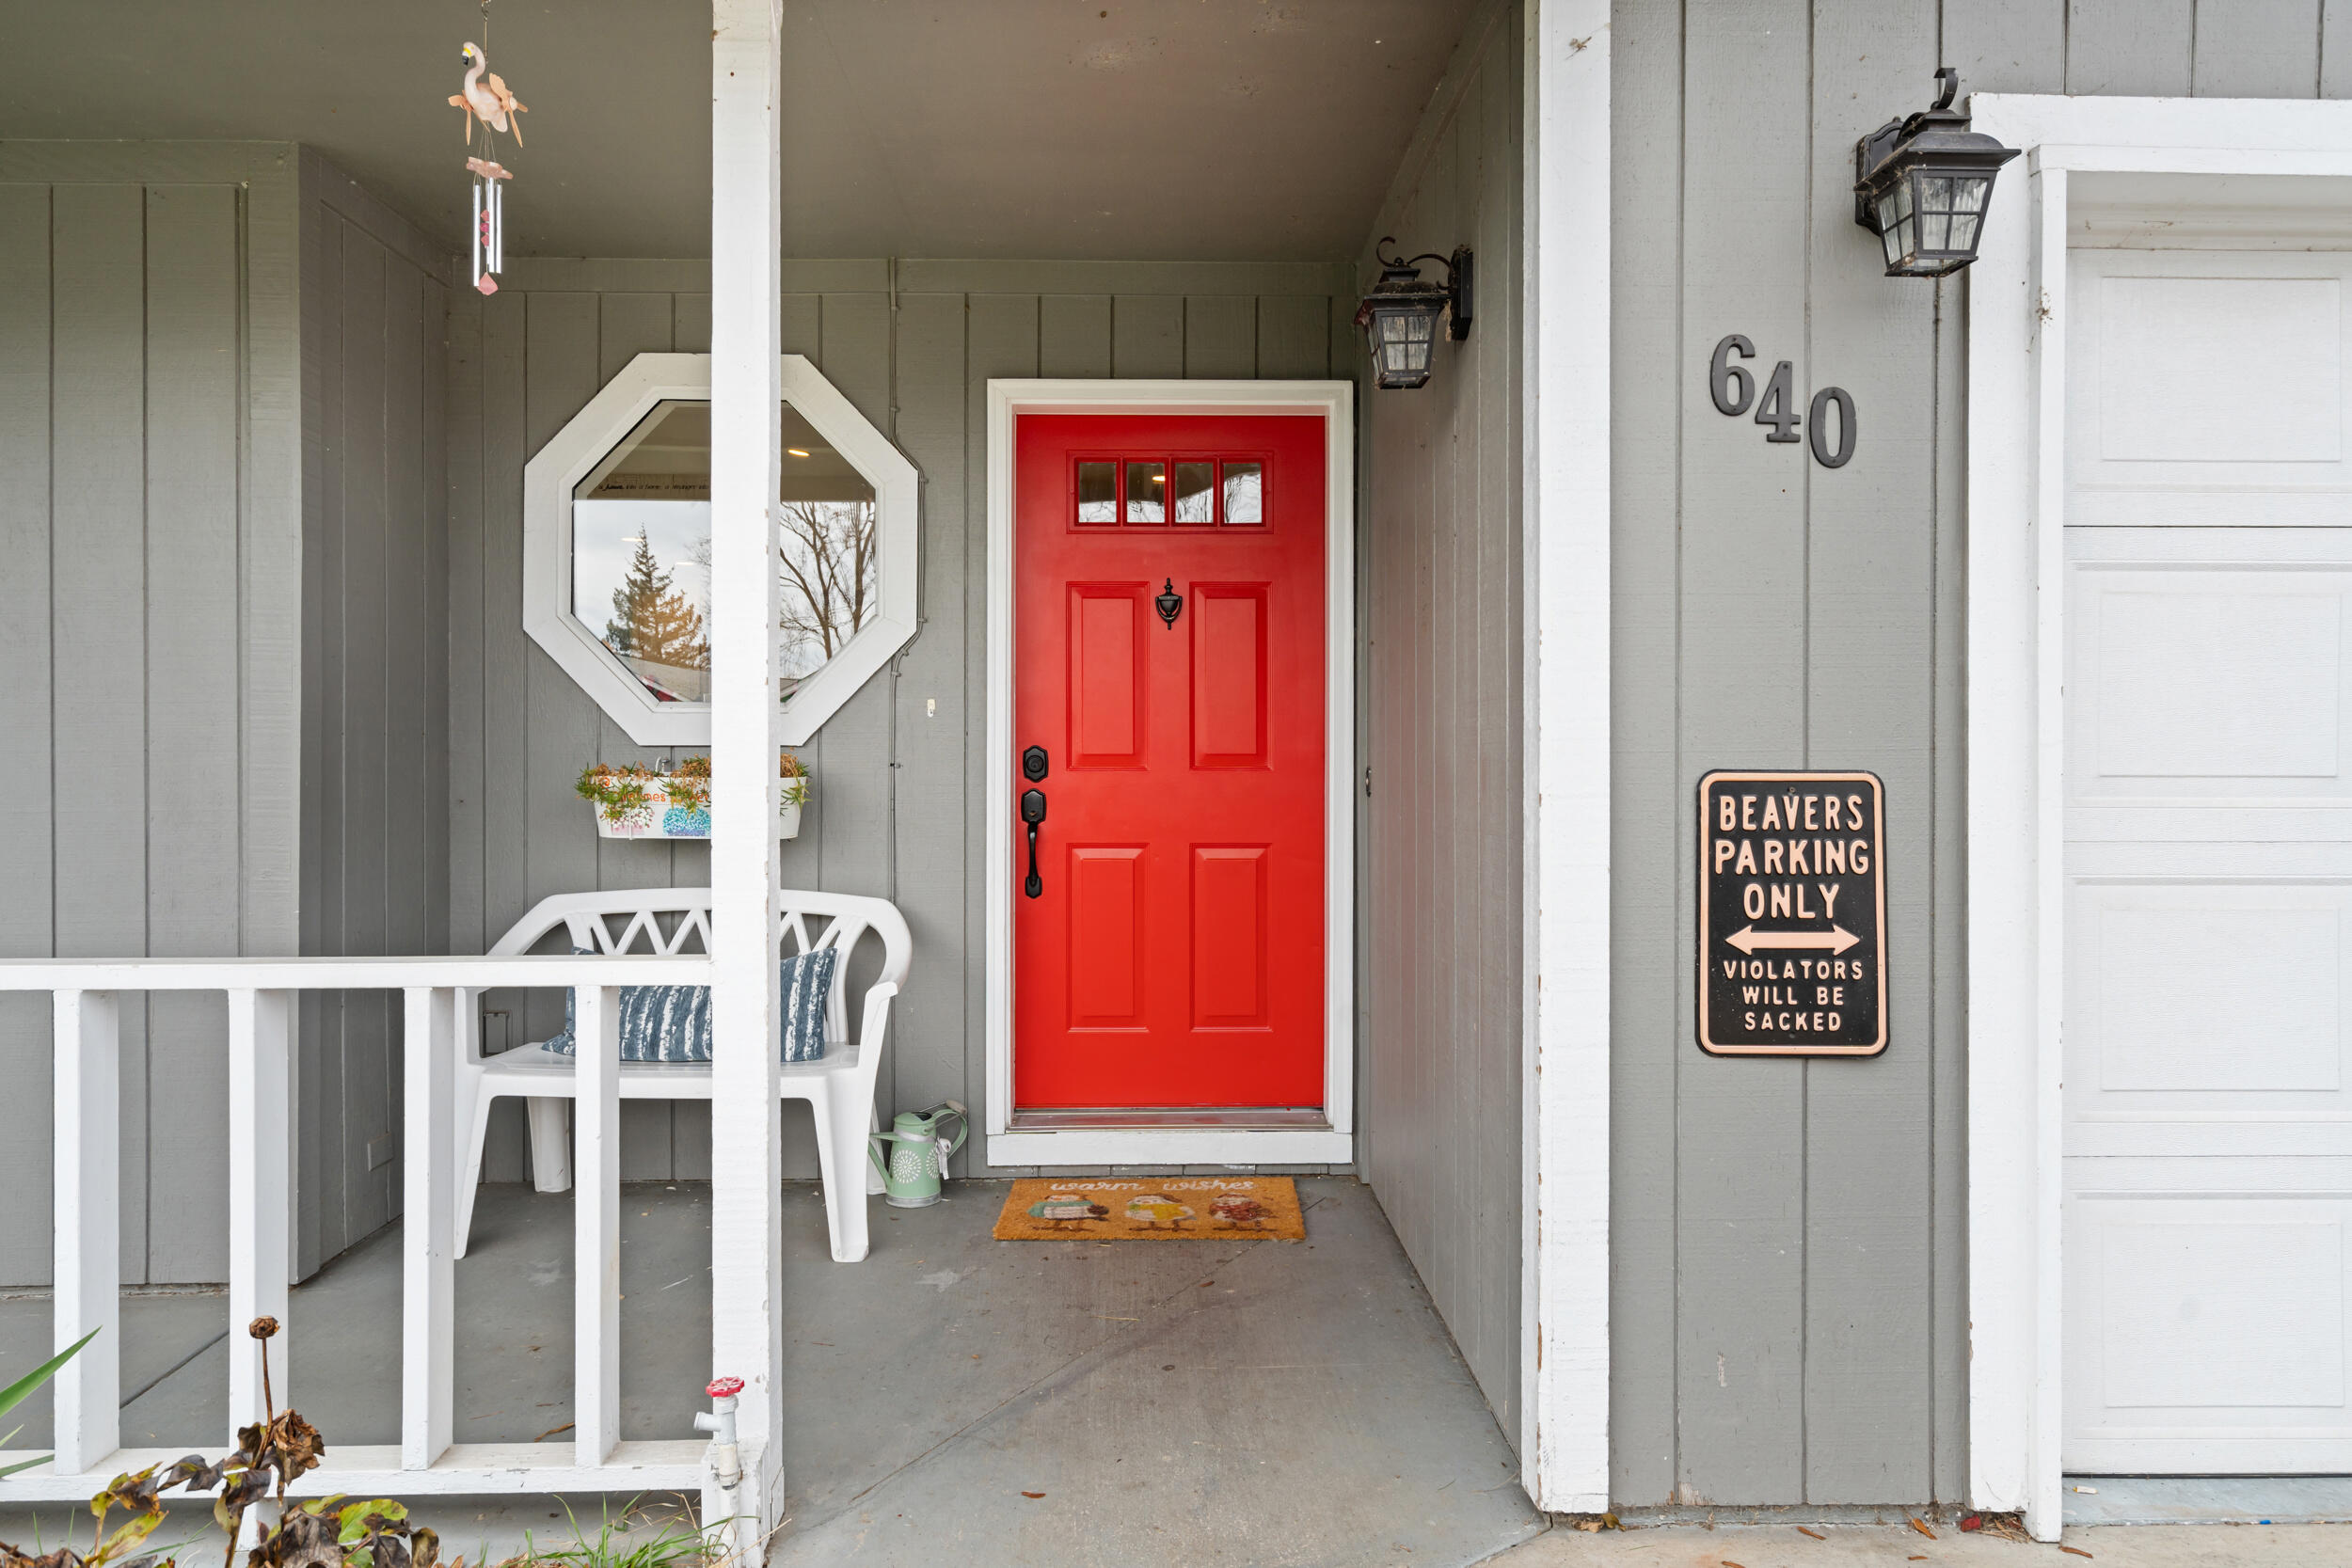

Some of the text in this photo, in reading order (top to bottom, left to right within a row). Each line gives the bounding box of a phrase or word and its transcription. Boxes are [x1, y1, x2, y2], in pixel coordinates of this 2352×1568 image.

[1710, 334, 1856, 468] 640
[1720, 794, 1863, 831] BEAVERS
[1716, 839, 1868, 874] PARKING
[1744, 882, 1839, 919] ONLY
[1724, 959, 1862, 979] VIOLATORS
[1742, 987, 1843, 1005] WILL BE
[1745, 1012, 1840, 1031] SACKED
[1051, 1180, 1254, 1191] warm wishes
